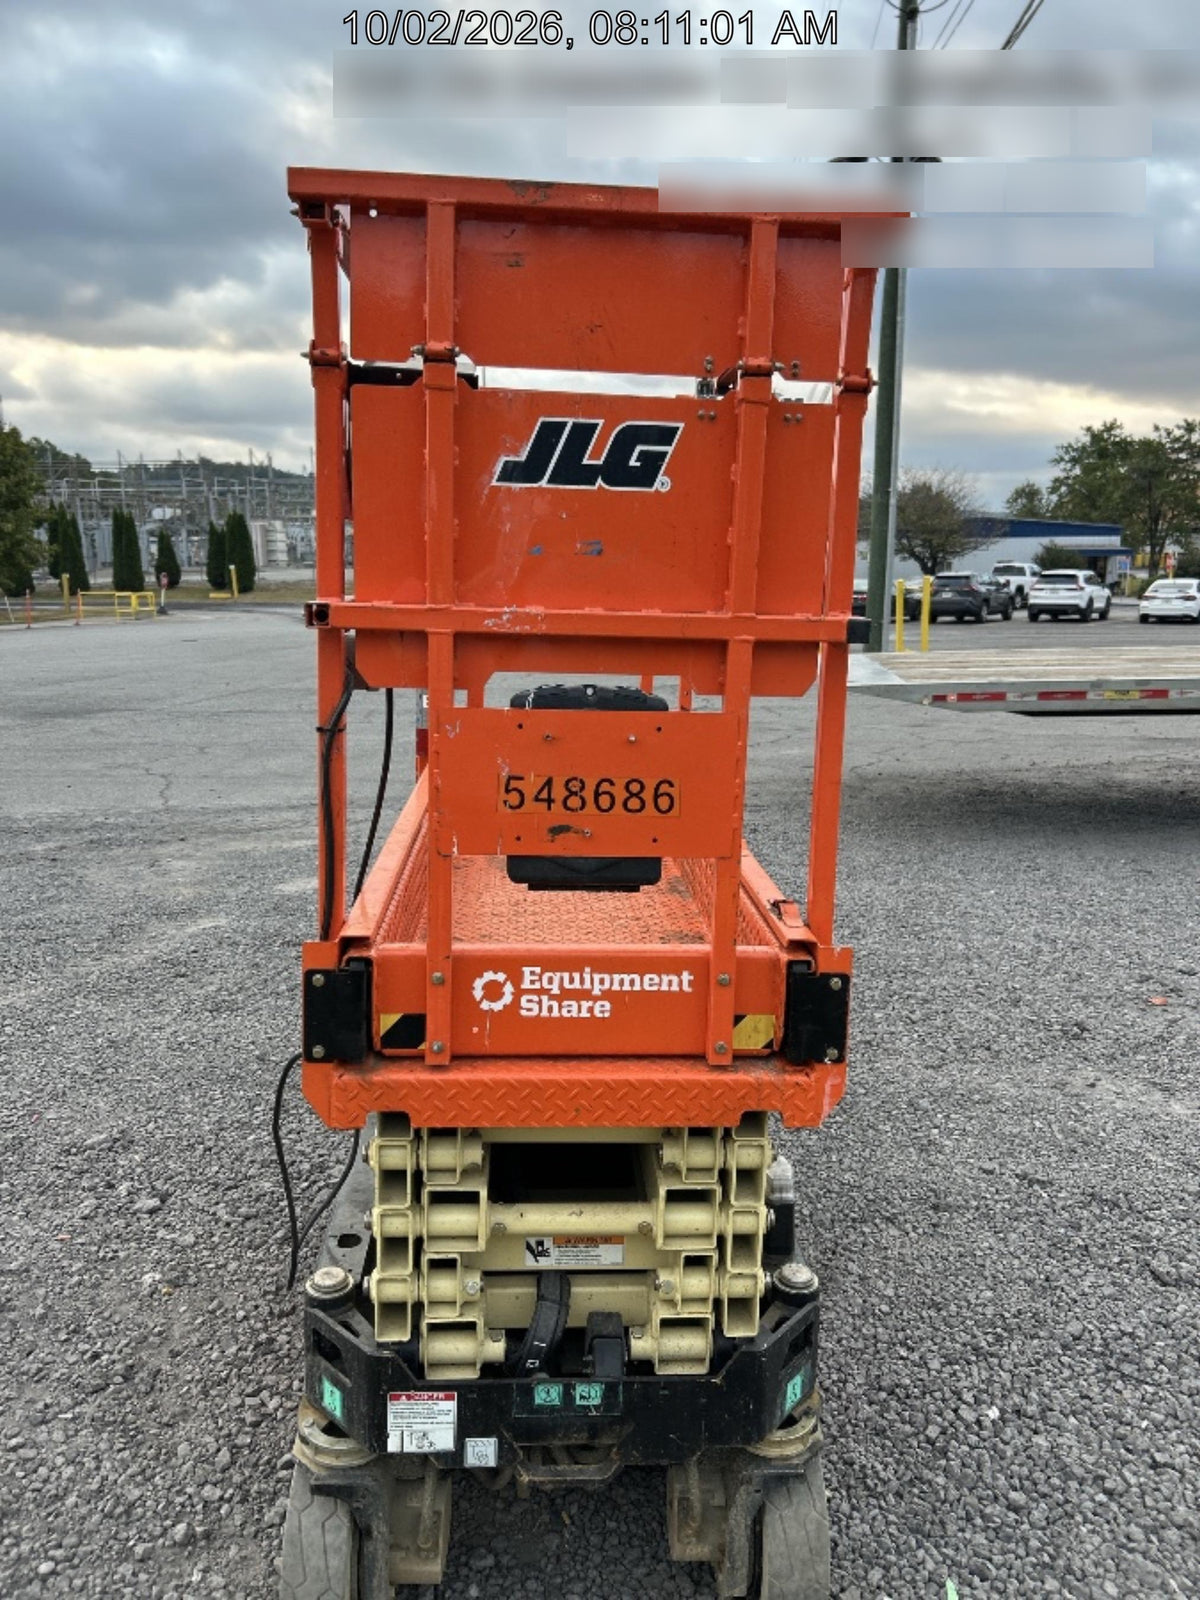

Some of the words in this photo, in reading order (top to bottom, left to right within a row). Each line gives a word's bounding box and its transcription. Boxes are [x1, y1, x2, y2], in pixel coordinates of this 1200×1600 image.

[503, 776, 675, 814] 548686
[521, 967, 693, 994] Equipment
[520, 996, 611, 1018] Share
